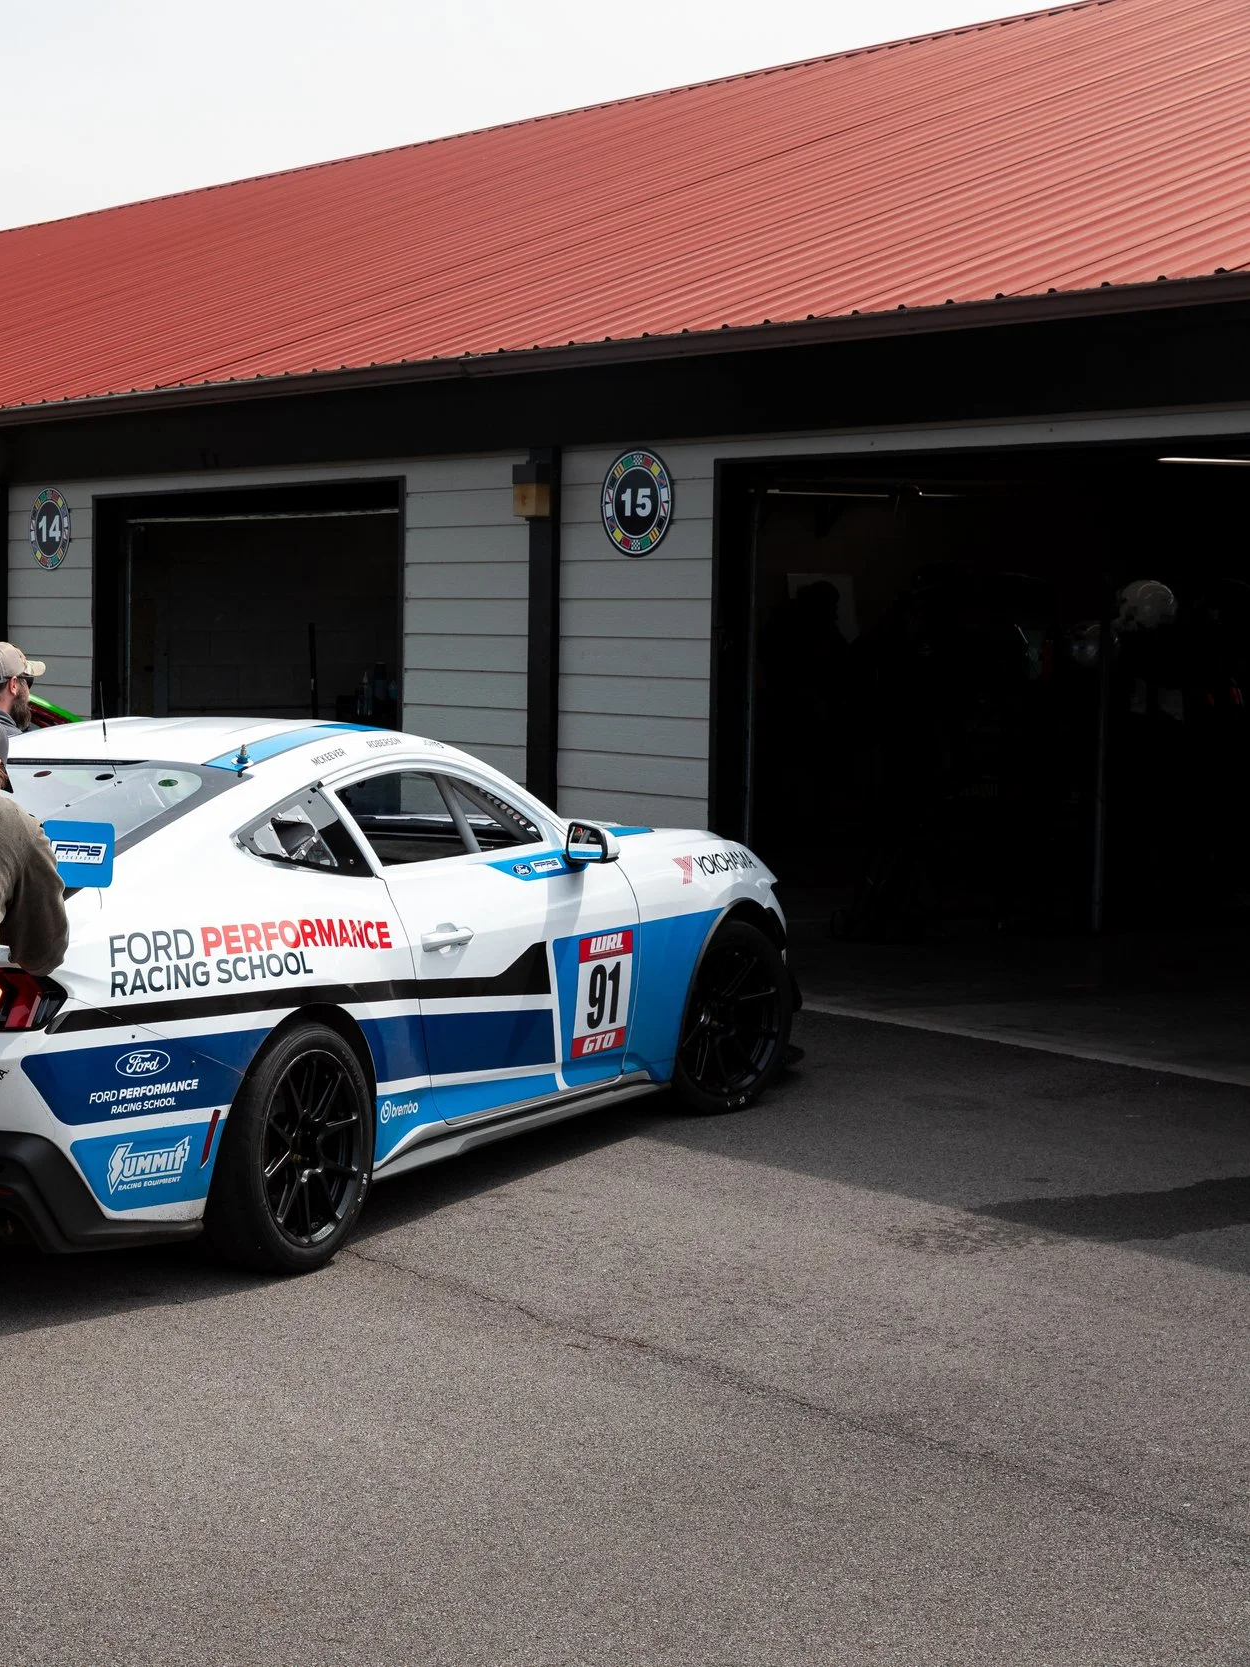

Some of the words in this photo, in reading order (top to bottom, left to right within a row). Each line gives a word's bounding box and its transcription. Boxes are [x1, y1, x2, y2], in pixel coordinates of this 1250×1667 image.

[621, 487, 653, 517] 15
[38, 515, 61, 543] 14
[366, 737, 403, 749] ROBERSON
[310, 747, 347, 767] MCKEEVER
[693, 850, 758, 876] YOKOHAMA
[108, 928, 195, 968] FORD
[200, 918, 393, 957] PERFORMANCE
[590, 932, 624, 953] WRL
[110, 961, 210, 998] RACING
[217, 950, 314, 984] SCHOOL
[586, 961, 622, 1030] 91
[582, 1031, 616, 1054] GTO
[125, 1053, 160, 1074] Ford
[89, 1090, 118, 1104] FORD
[118, 1079, 199, 1100] PERFORMANCE
[111, 1102, 141, 1114] RACING
[143, 1097, 177, 1110] SCHOOL
[391, 1100, 419, 1118] brembo
[118, 1181, 142, 1191] RACING
[143, 1176, 181, 1187] EQUIPMENT
